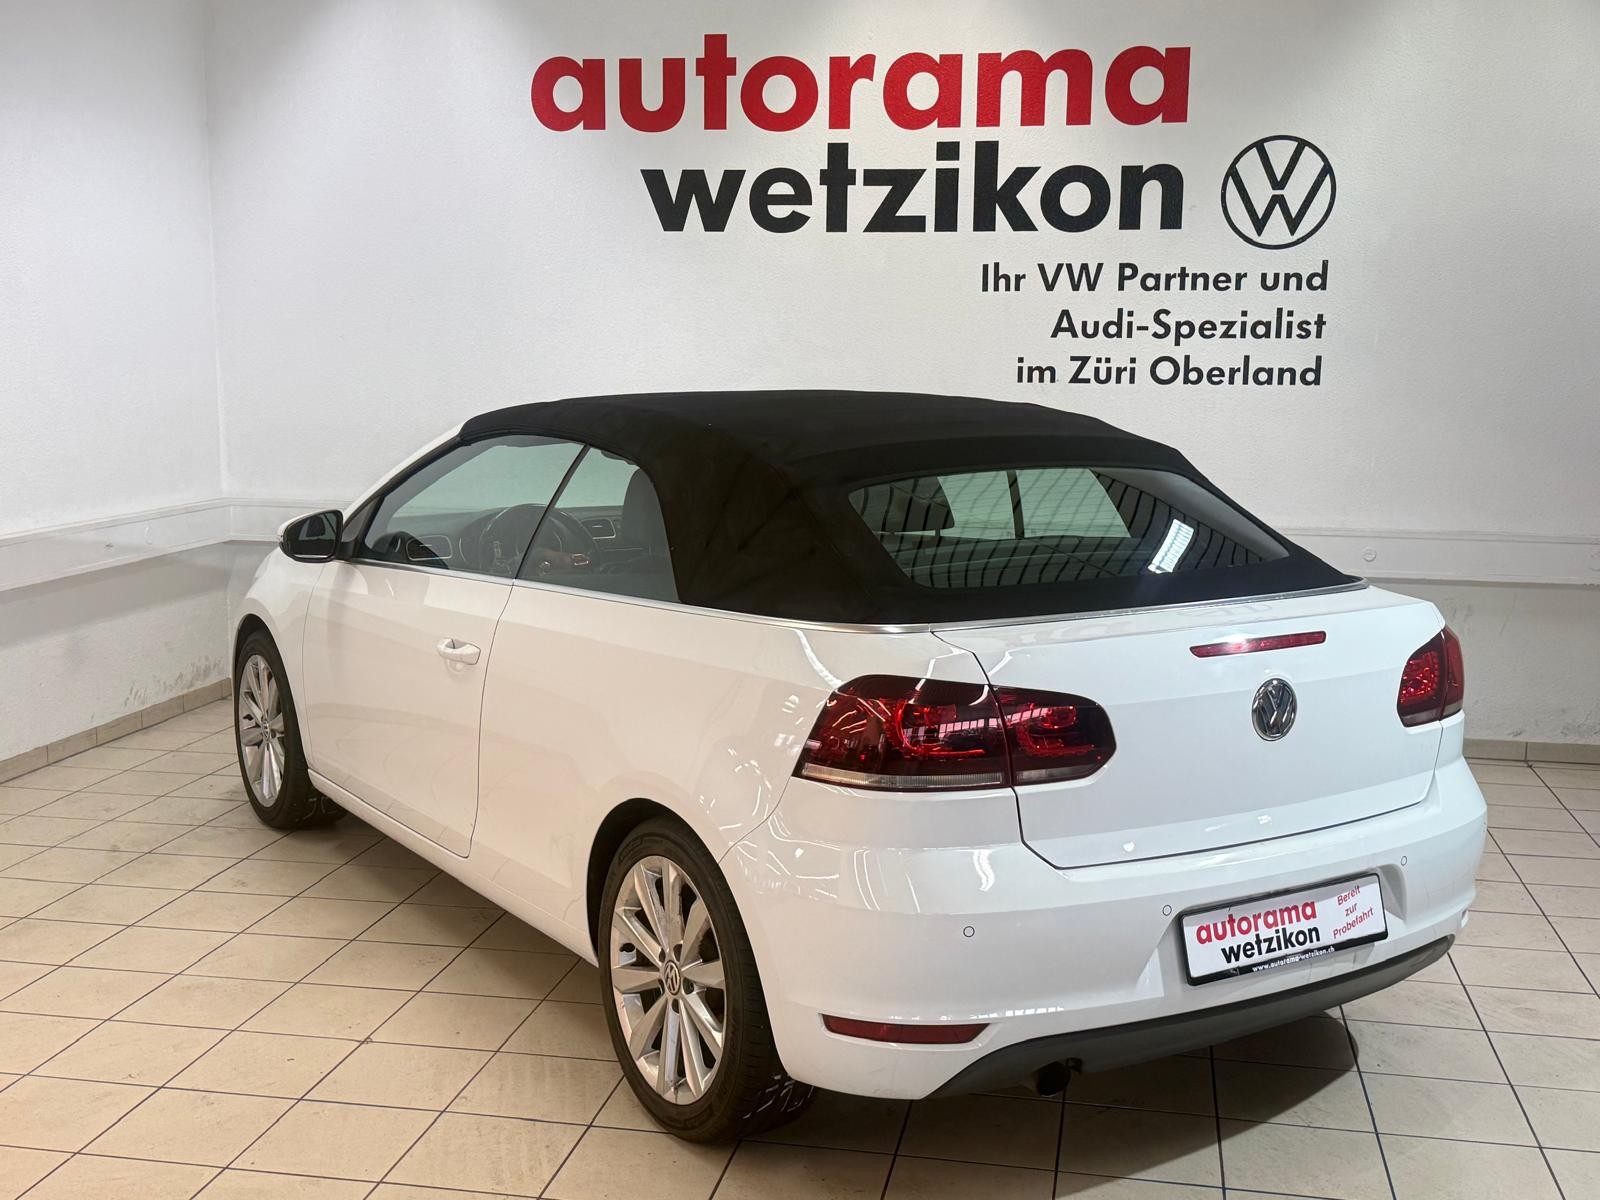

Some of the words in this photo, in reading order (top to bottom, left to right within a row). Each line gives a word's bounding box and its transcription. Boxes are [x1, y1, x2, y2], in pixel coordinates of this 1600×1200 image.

[531, 34, 1192, 133] autorama
[641, 140, 1184, 233] wetzikon
[1222, 136, 1335, 248] VW
[981, 261, 1027, 293] Ihr
[1037, 262, 1105, 292] VW
[1117, 262, 1248, 292] Partner
[1260, 259, 1329, 292] und
[1051, 307, 1327, 347] Audi-Spezialist
[1017, 356, 1056, 384] im
[1068, 355, 1136, 385] Züri
[1149, 354, 1323, 386] Oberland
[1337, 885, 1361, 906] Bereit
[1344, 902, 1358, 917] zur
[1196, 901, 1317, 945] autorama
[1332, 906, 1374, 939] Probefahrt
[1221, 926, 1321, 964] wetzikon
